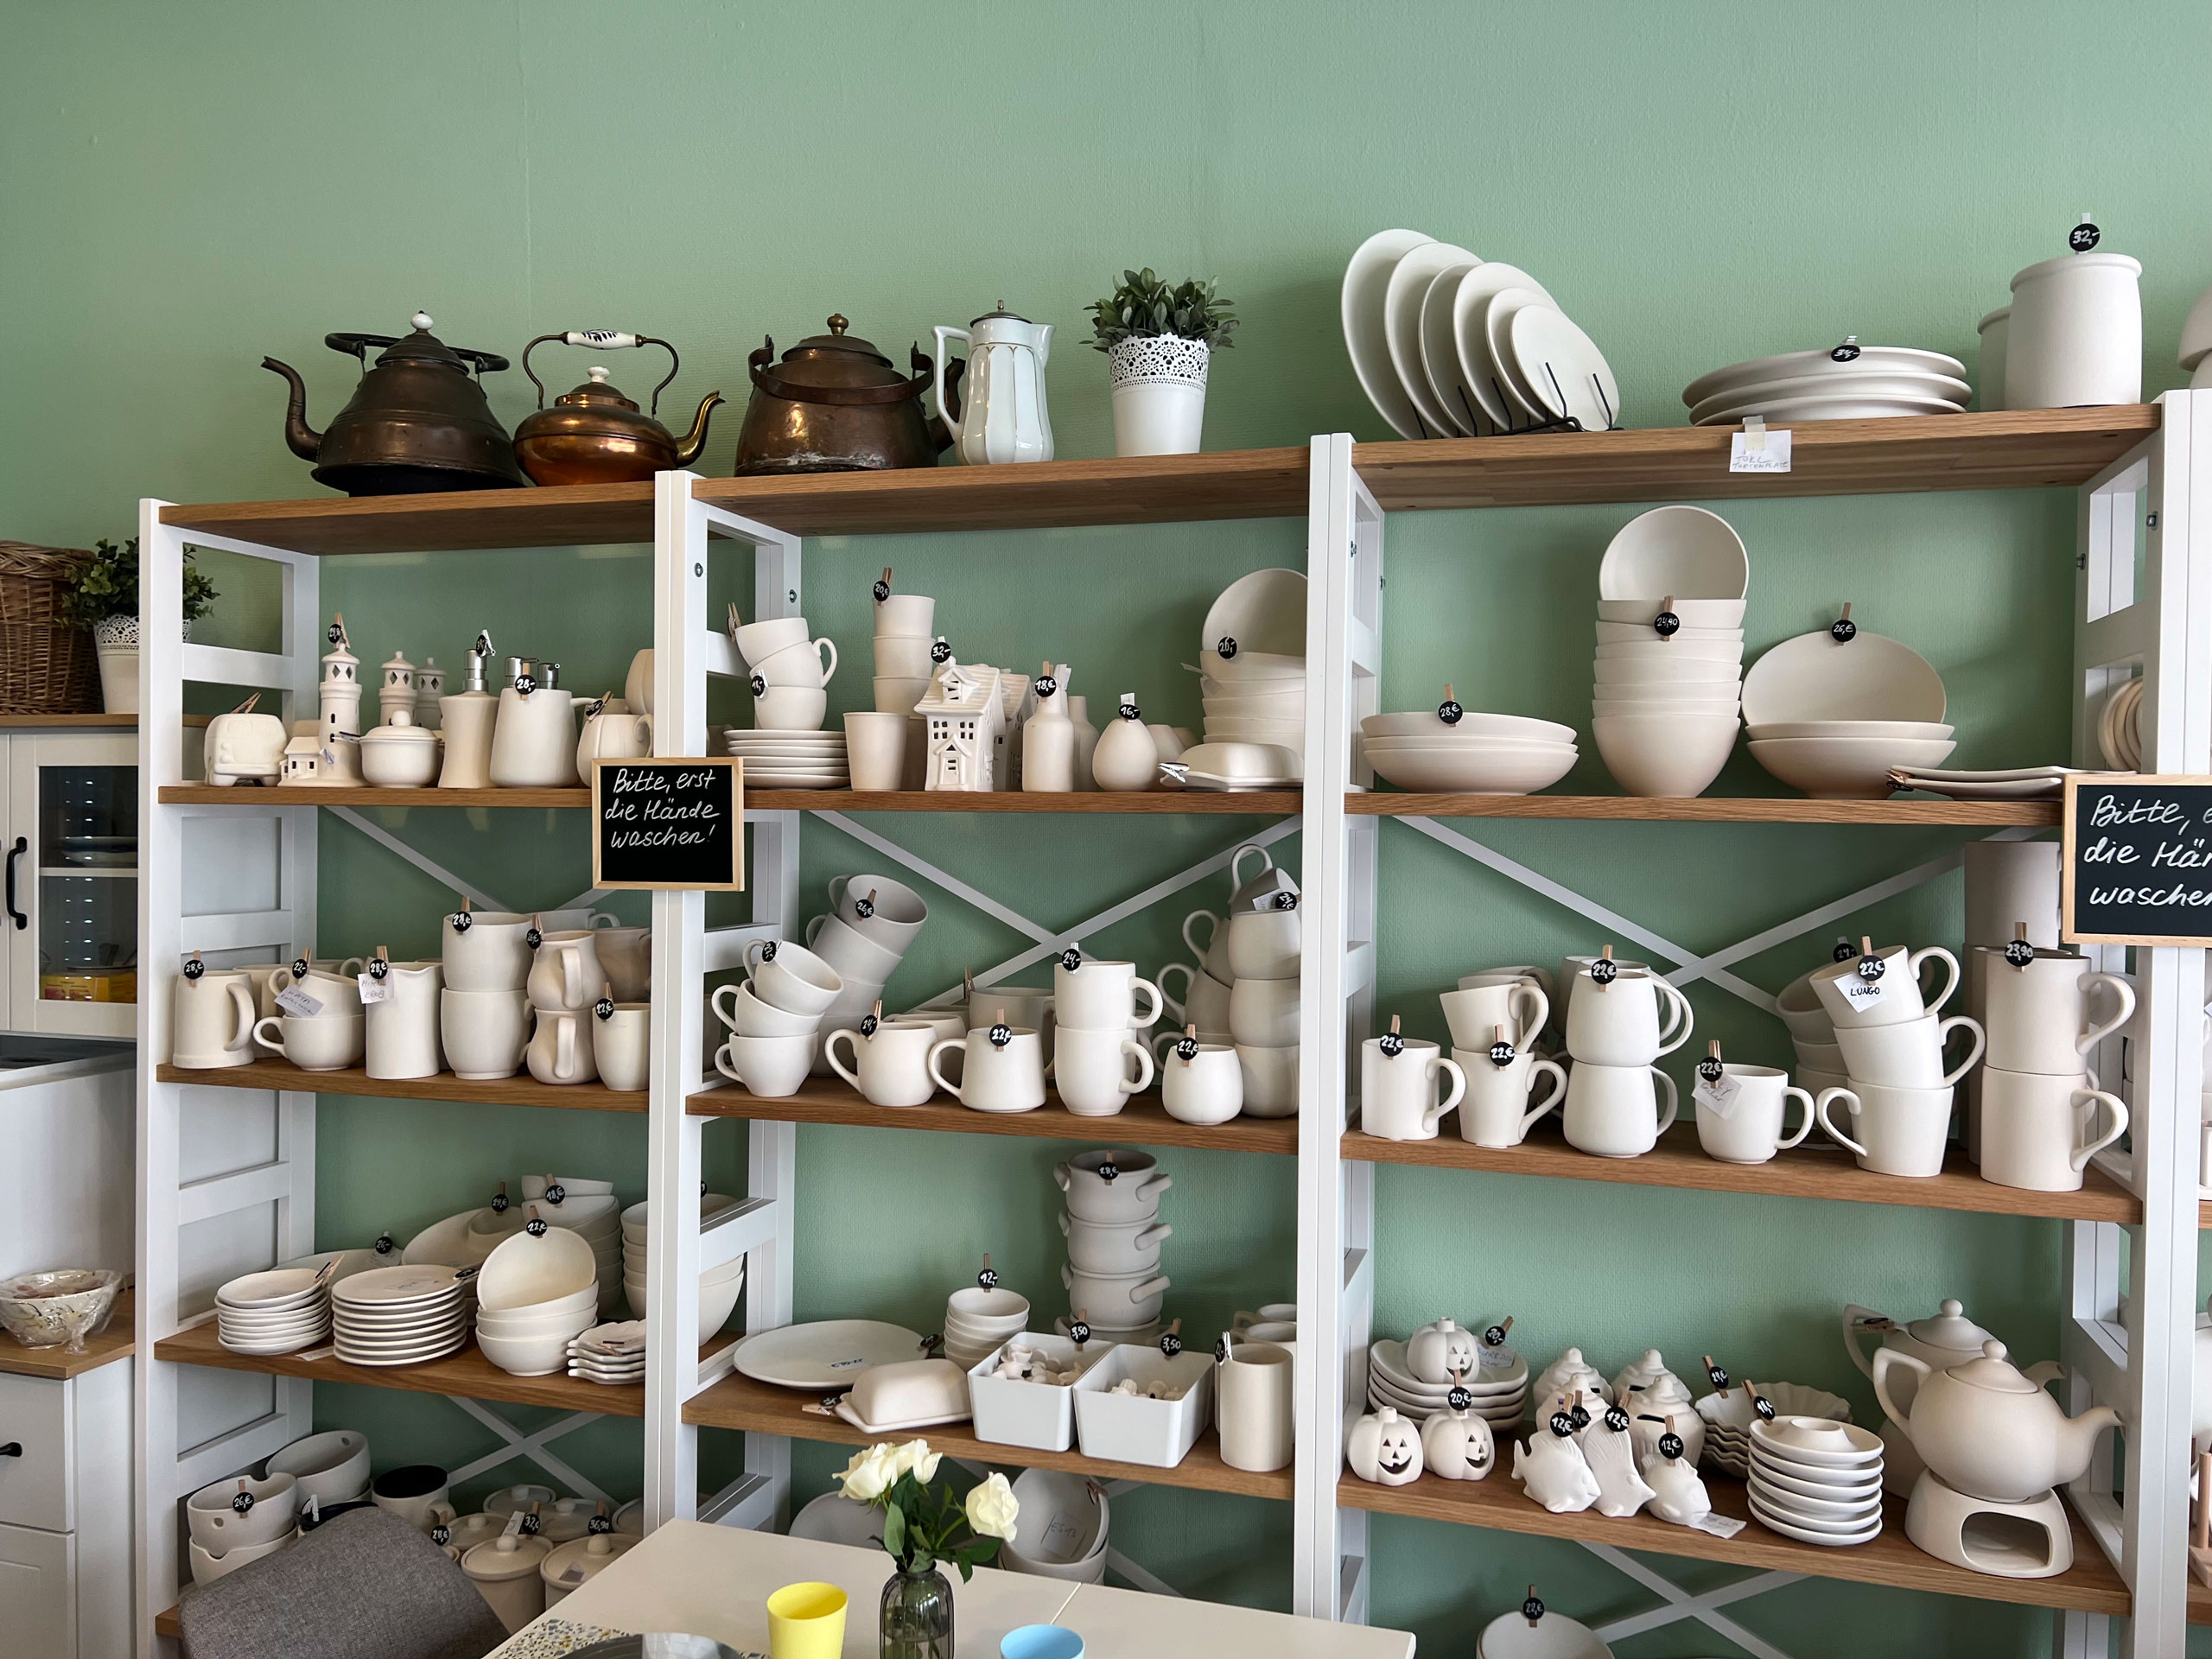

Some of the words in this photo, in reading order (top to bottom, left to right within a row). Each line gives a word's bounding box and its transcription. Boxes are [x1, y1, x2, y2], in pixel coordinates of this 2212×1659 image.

[613, 768, 671, 793] Bitte,
[676, 768, 716, 789] erst
[605, 798, 638, 821] die
[644, 798, 721, 821] Hände
[2090, 794, 2190, 836] Bitte,
[610, 824, 716, 849] waschen!
[2083, 836, 2141, 864] die
[1850, 987, 1880, 996] LUNGO
[1071, 1326, 1087, 1339] 3,50
[1163, 1338, 1180, 1352] 3,50
